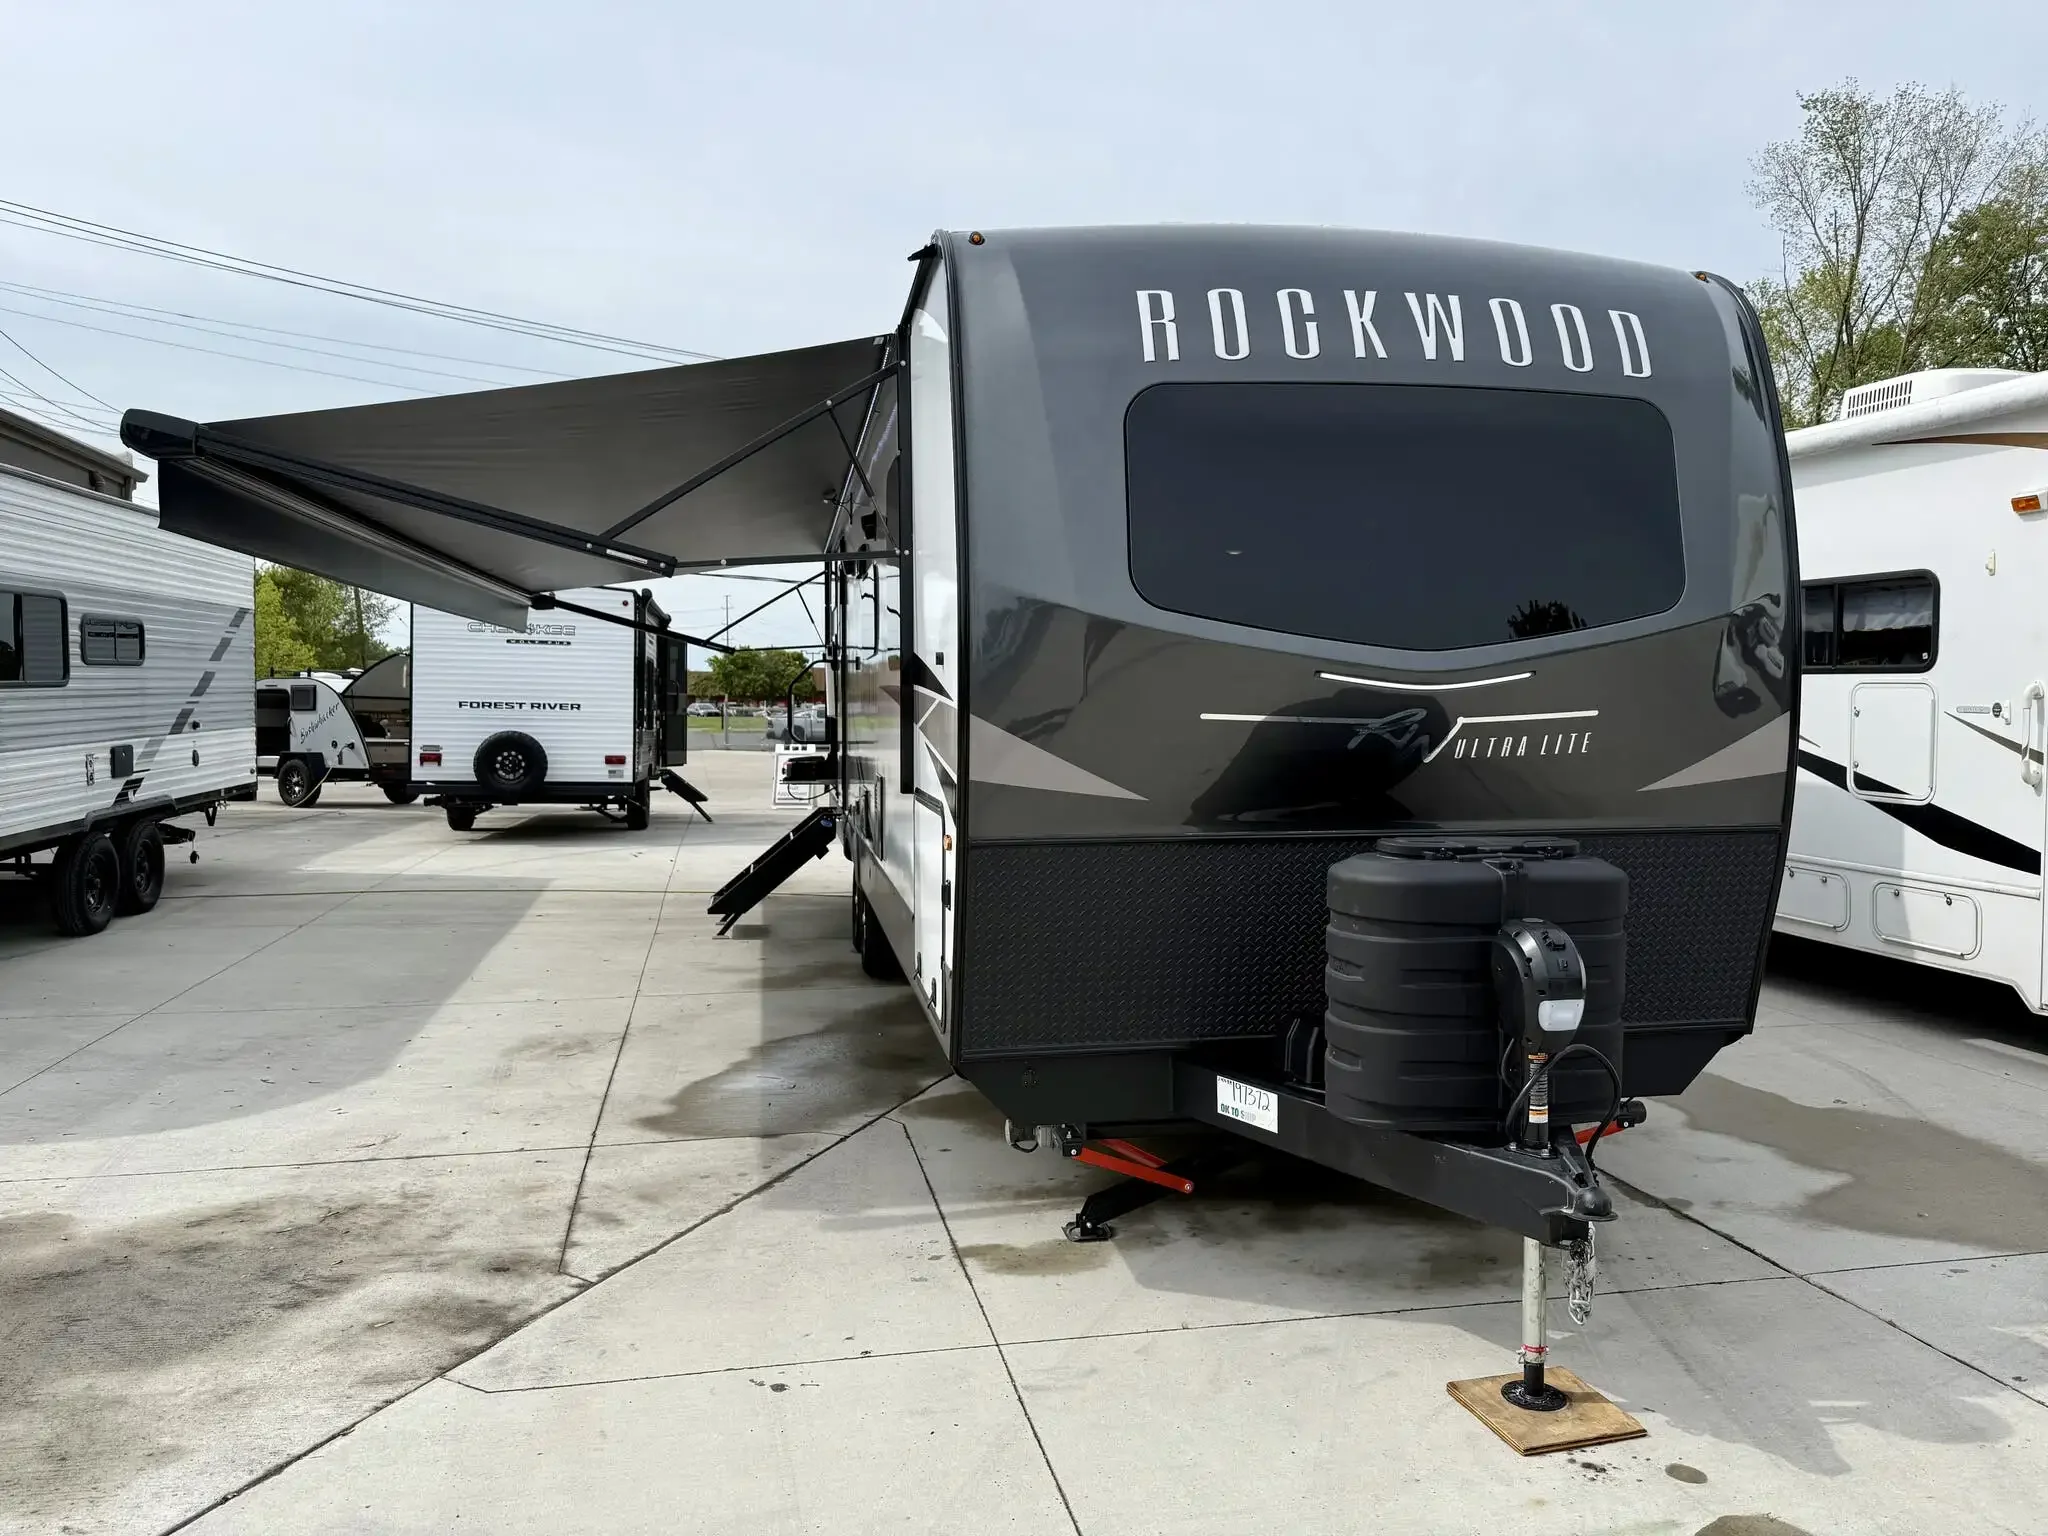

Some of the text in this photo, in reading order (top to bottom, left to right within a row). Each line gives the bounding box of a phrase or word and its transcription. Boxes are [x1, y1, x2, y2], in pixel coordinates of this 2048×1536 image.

[1135, 287, 1653, 379] ROCKWOOD
[458, 700, 581, 711] FOREST RIVER
[1453, 731, 1593, 760] ULTRA LITE
[1220, 1103, 1230, 1115] OK
[1231, 1106, 1240, 1118] TO
[1231, 1080, 1271, 1112] 197372
